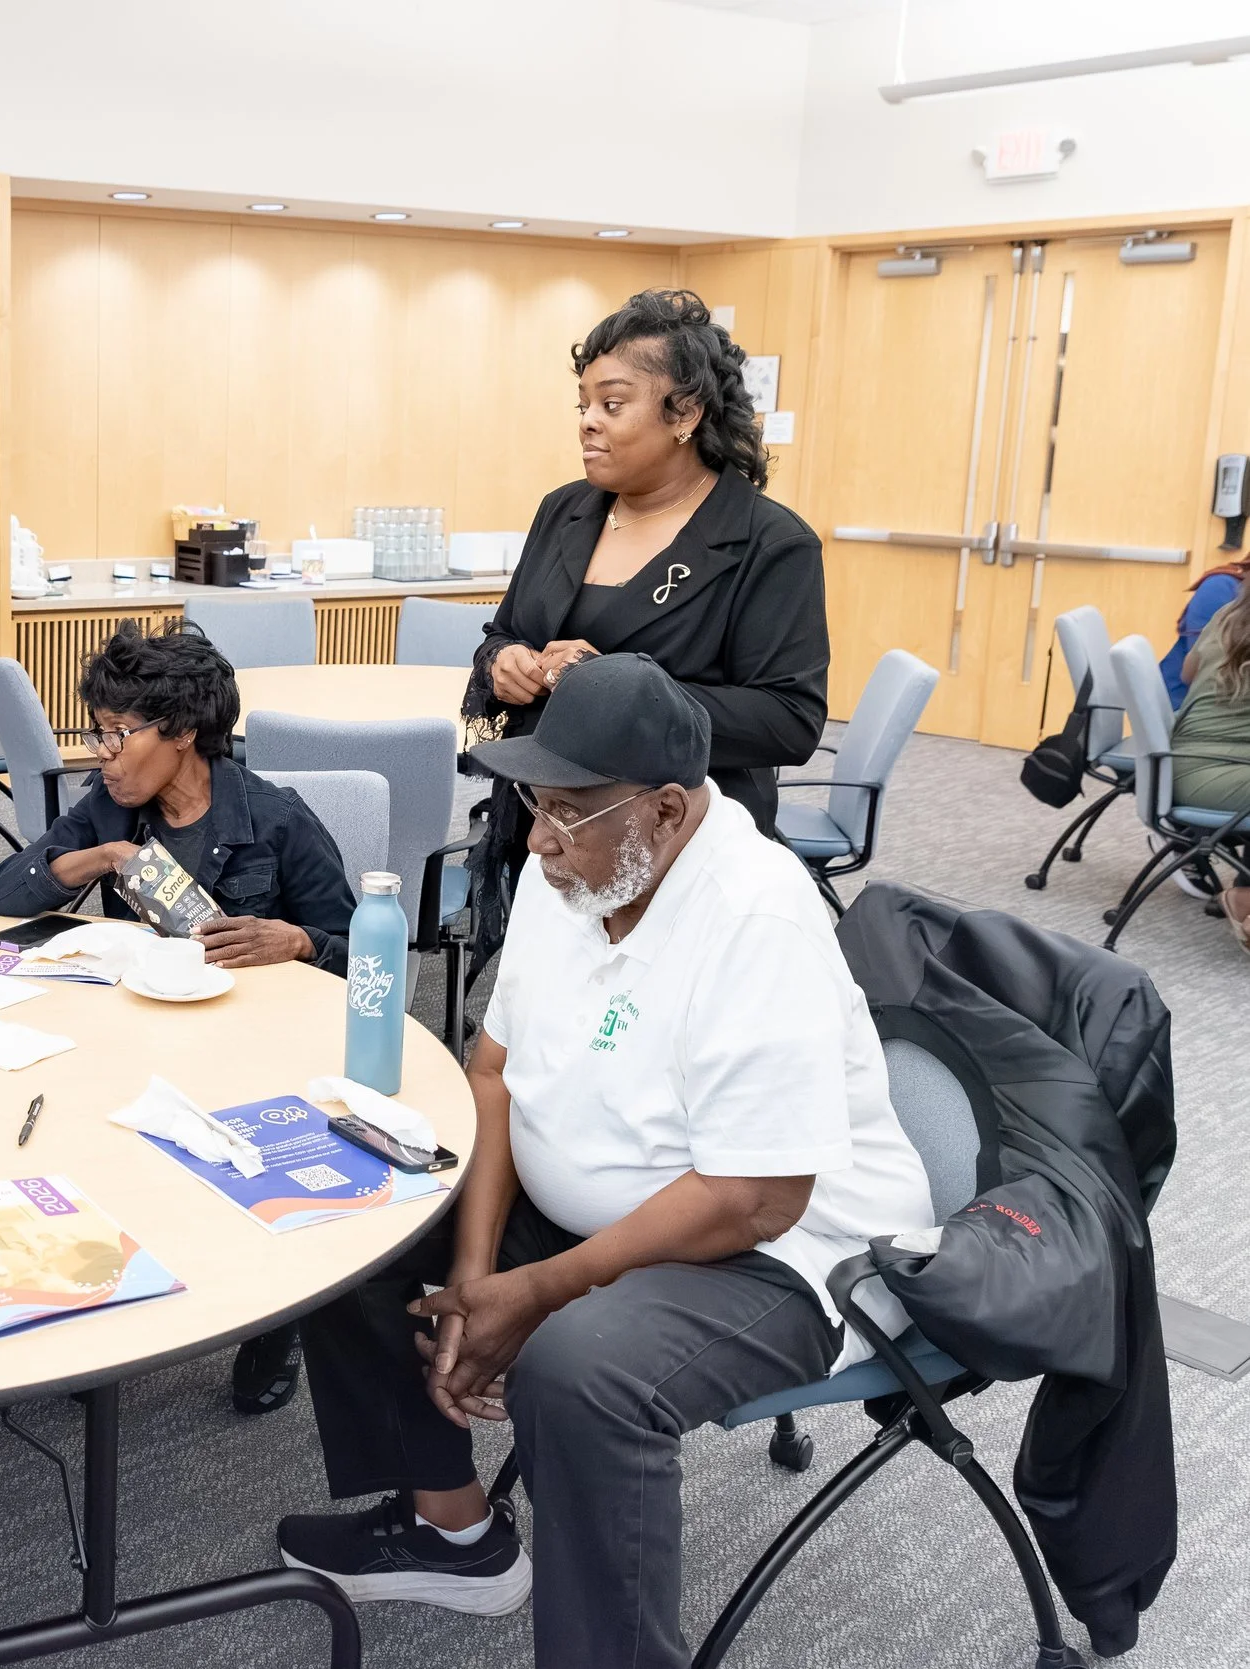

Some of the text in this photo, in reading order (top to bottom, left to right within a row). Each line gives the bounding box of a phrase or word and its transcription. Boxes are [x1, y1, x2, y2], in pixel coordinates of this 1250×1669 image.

[184, 902, 206, 920] WHITE
[19, 1179, 69, 1213] 2026
[995, 1204, 1042, 1236] HOLDER
